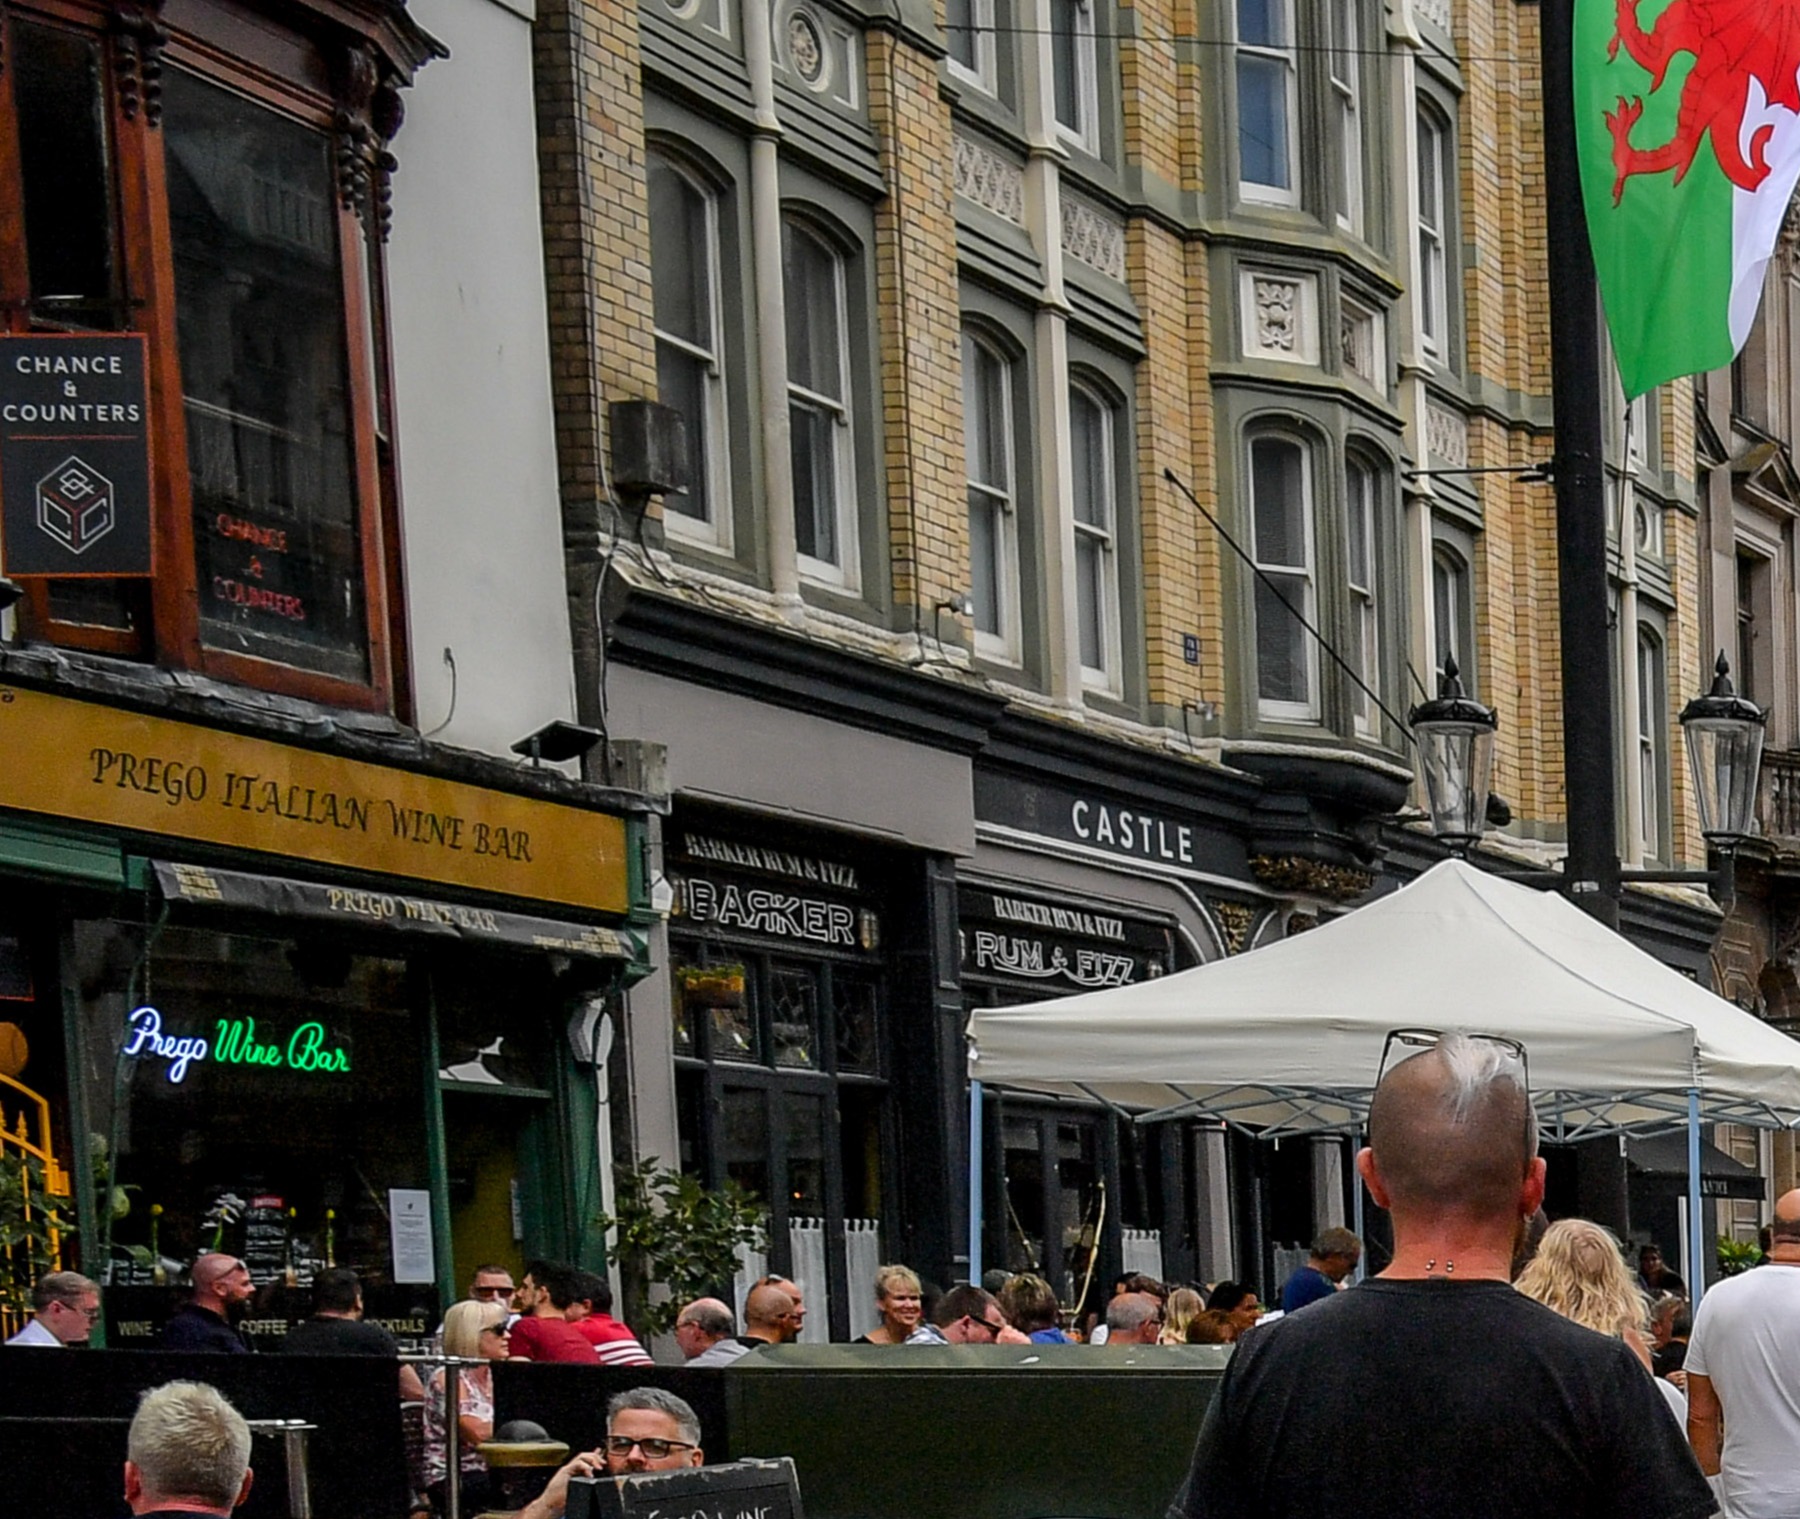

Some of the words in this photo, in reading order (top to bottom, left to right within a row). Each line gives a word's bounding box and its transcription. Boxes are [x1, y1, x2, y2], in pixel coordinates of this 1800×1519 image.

[16, 356, 122, 374] CHANCE
[63, 380, 77, 397] &
[3, 404, 140, 421] COUNTERS
[90, 747, 207, 805] PREGO
[221, 772, 373, 832] ITALIAN
[386, 800, 463, 849] WINE
[473, 823, 534, 862] BAR
[685, 833, 762, 868] BARKER
[1072, 800, 1193, 863] CASTLE
[327, 888, 396, 920] PREGO
[402, 896, 454, 926] WINE
[456, 908, 499, 933] BAR
[993, 896, 1053, 927] BARKER
[1051, 907, 1084, 934] RUM
[1082, 914, 1096, 935] &
[975, 931, 1044, 972] RUM
[1077, 949, 1135, 986] FIZZ
[124, 1007, 207, 1083] Prego
[214, 1016, 282, 1066] Wine
[288, 1021, 351, 1071] Bar
[118, 1320, 153, 1336] WINE
[239, 1319, 287, 1334] COFFEE
